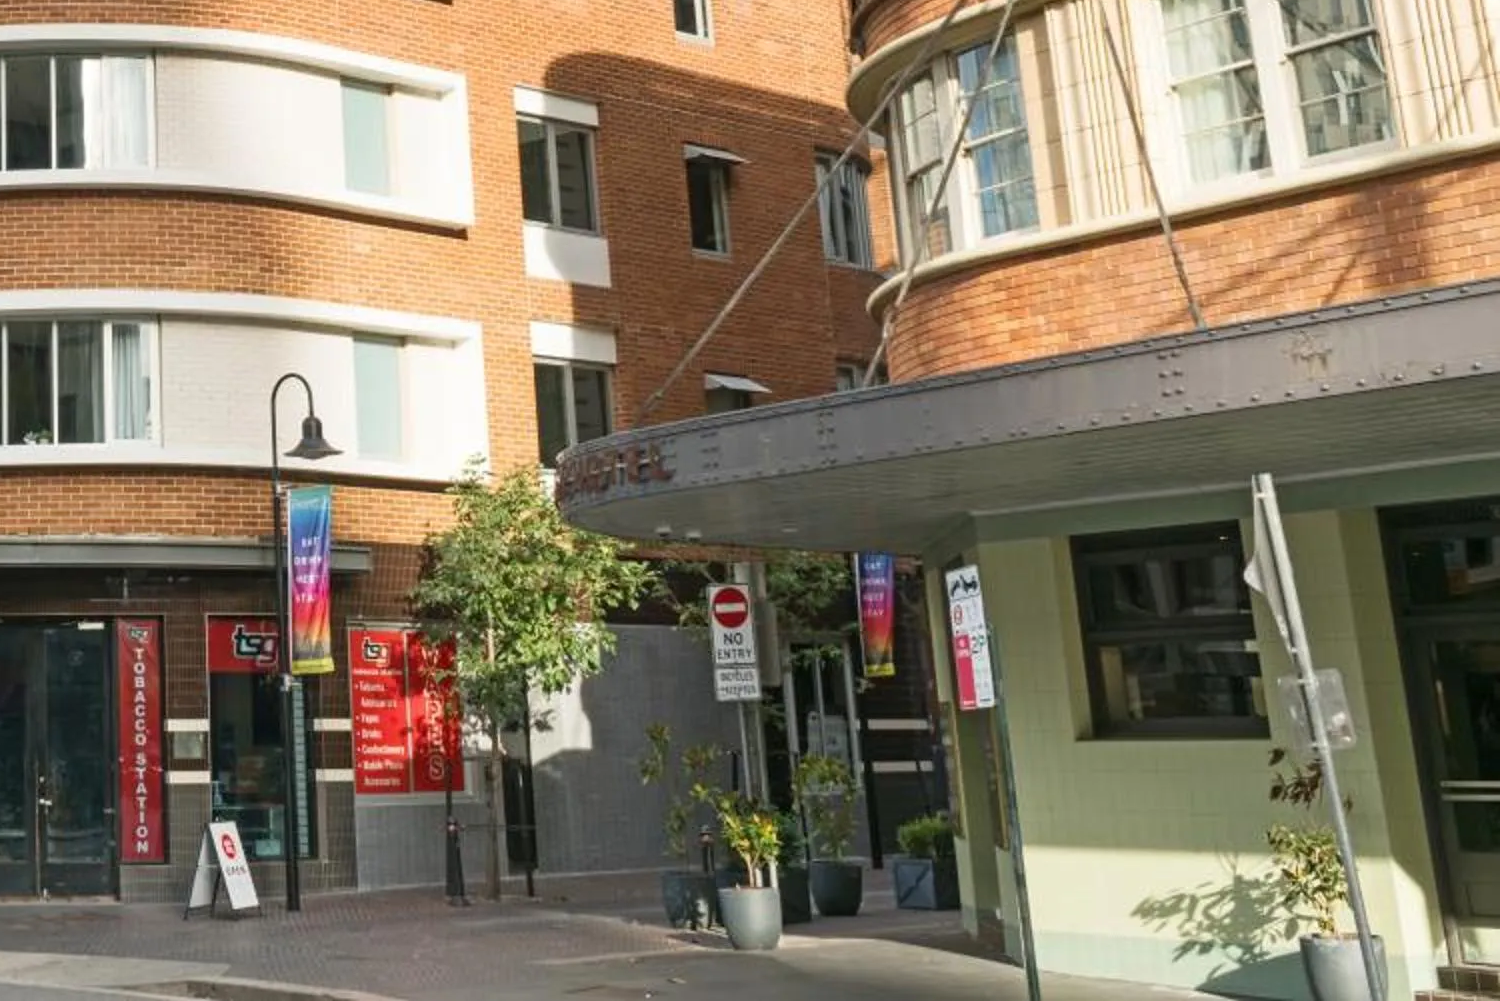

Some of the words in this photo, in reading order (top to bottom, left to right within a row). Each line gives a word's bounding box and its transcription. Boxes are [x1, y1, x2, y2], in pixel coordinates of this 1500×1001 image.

[232, 625, 278, 667] tsg
[717, 648, 752, 659] ENTRY
[723, 632, 743, 645] NO
[133, 648, 147, 746] TOBACCO
[136, 752, 149, 853] STATION
